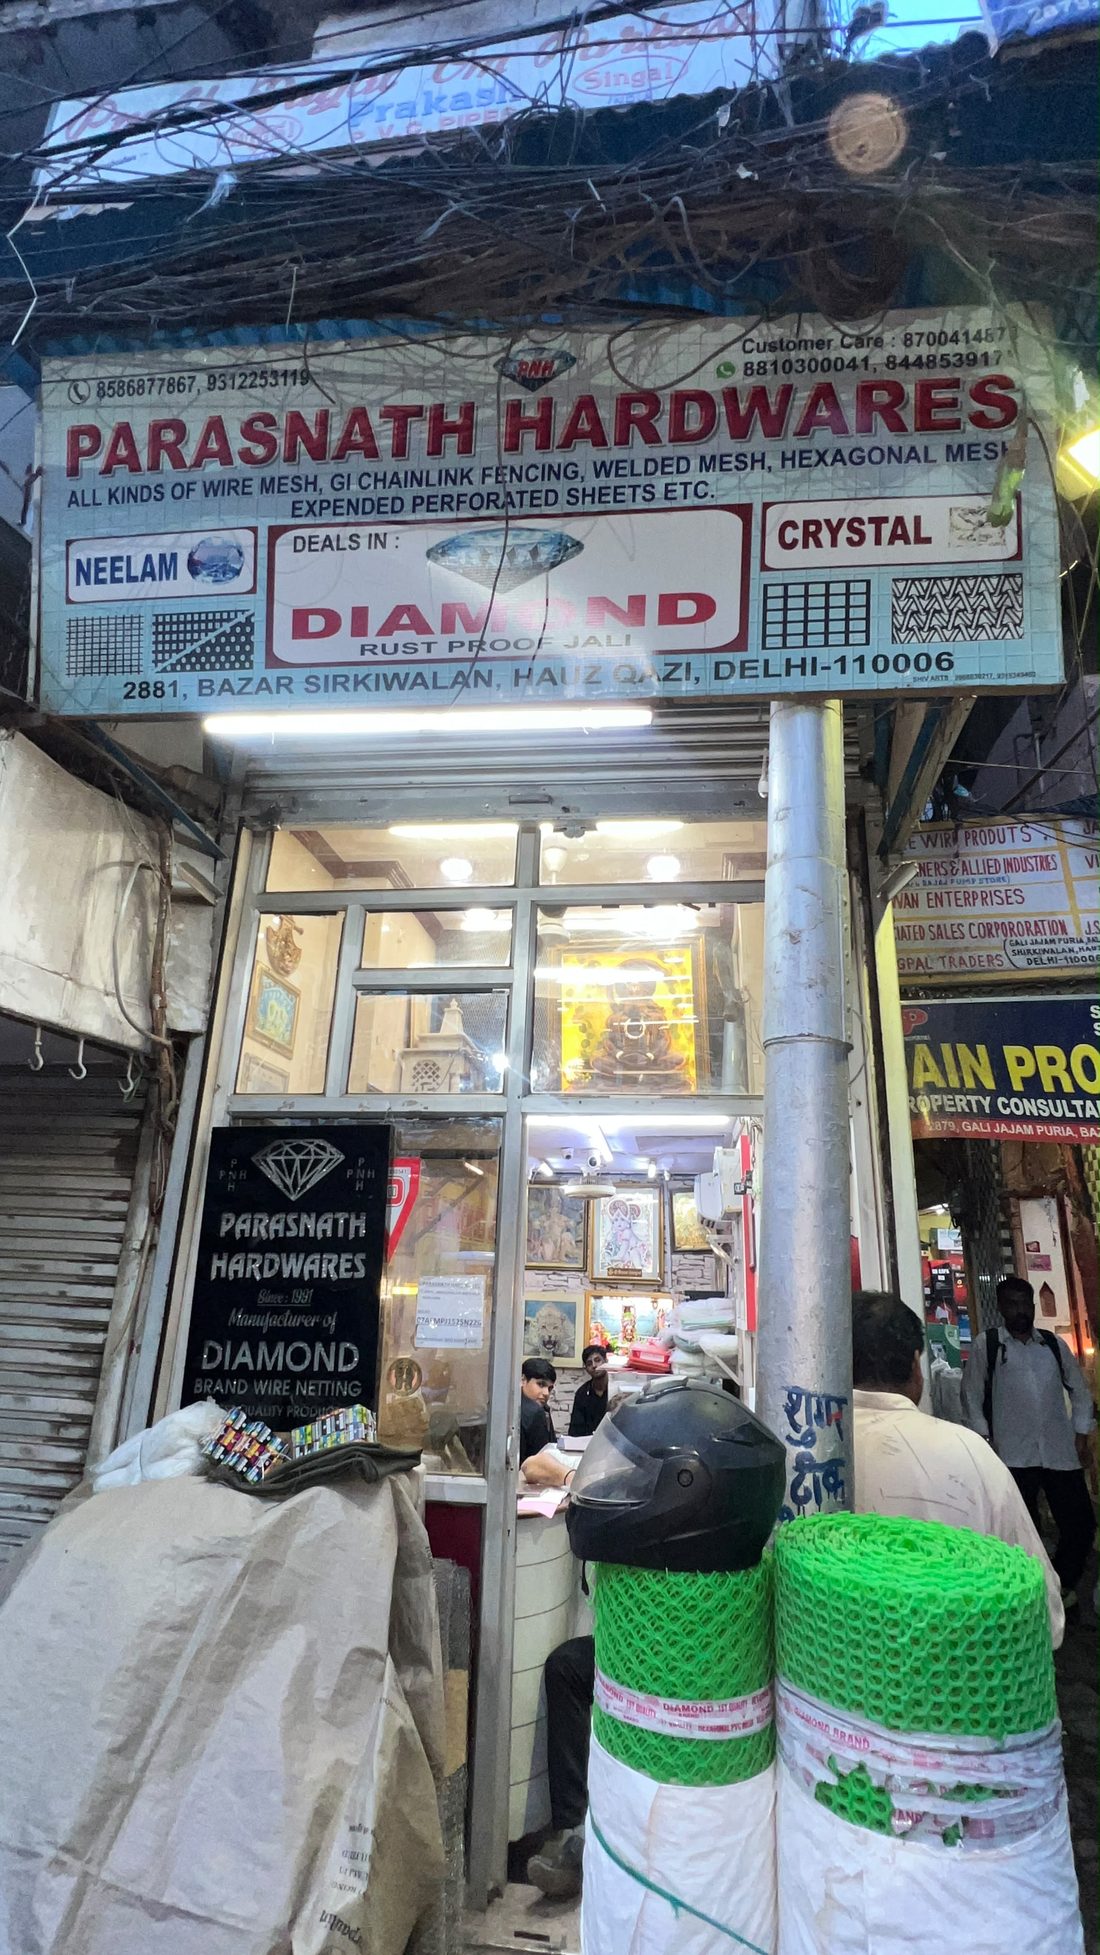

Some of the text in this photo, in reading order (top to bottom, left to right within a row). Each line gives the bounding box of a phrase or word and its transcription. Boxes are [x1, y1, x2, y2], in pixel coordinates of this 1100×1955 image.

[583, 67, 674, 89] Singal
[742, 337, 833, 354] Customer
[840, 333, 884, 349] Care
[743, 350, 1013, 377] 8810300041, 844853917
[97, 376, 200, 399] 8586877867,
[66, 374, 1018, 479] PARASNATH HARDWARES
[67, 490, 102, 508] ALL
[108, 483, 165, 505] KINDS
[171, 481, 197, 500] OF
[203, 477, 253, 498] WIRE
[260, 475, 323, 494] MESH,
[330, 473, 351, 492] GI
[358, 467, 474, 490] CHAINLINK
[481, 462, 585, 484] FENCING,
[593, 456, 691, 479] WELDED
[699, 451, 772, 473] MESH,
[781, 445, 937, 469] HEXAGONAL
[291, 480, 715, 518] EXPENDED PERFORATED SHEETS ETC.
[293, 533, 361, 553] DEALS
[367, 532, 387, 550] IN
[777, 515, 932, 551] CRYSTAL
[74, 551, 178, 587] NEELAM
[292, 592, 717, 640] DIAMOND
[360, 634, 631, 656] RUST PROOF JALI
[123, 650, 955, 700] 2881, BAZAR SIRKIWALAN, HAUZ QAZI, DELHI-110006
[964, 825, 1032, 847] PRODUTS
[917, 861, 948, 878] NERS
[961, 858, 1000, 876] ALLIED
[1003, 854, 1058, 873] INDUSTRIES
[926, 888, 1025, 909] ENTERPRISES
[895, 922, 926, 941] IATED
[928, 922, 965, 941] SALES
[938, 953, 1004, 969] TRADERS
[997, 1097, 1100, 1118] CONSULTA
[962, 1121, 991, 1133] GALI
[994, 1122, 1033, 1136] JAJAM
[1036, 1124, 1078, 1138] PURIA,
[219, 1212, 367, 1240] PARASNATH
[210, 1252, 366, 1282] HARDWARES
[228, 1307, 338, 1335] Manufacturer of
[201, 1340, 360, 1372] DIAMOND
[193, 1378, 362, 1398] BRAND WIRE NETTING
